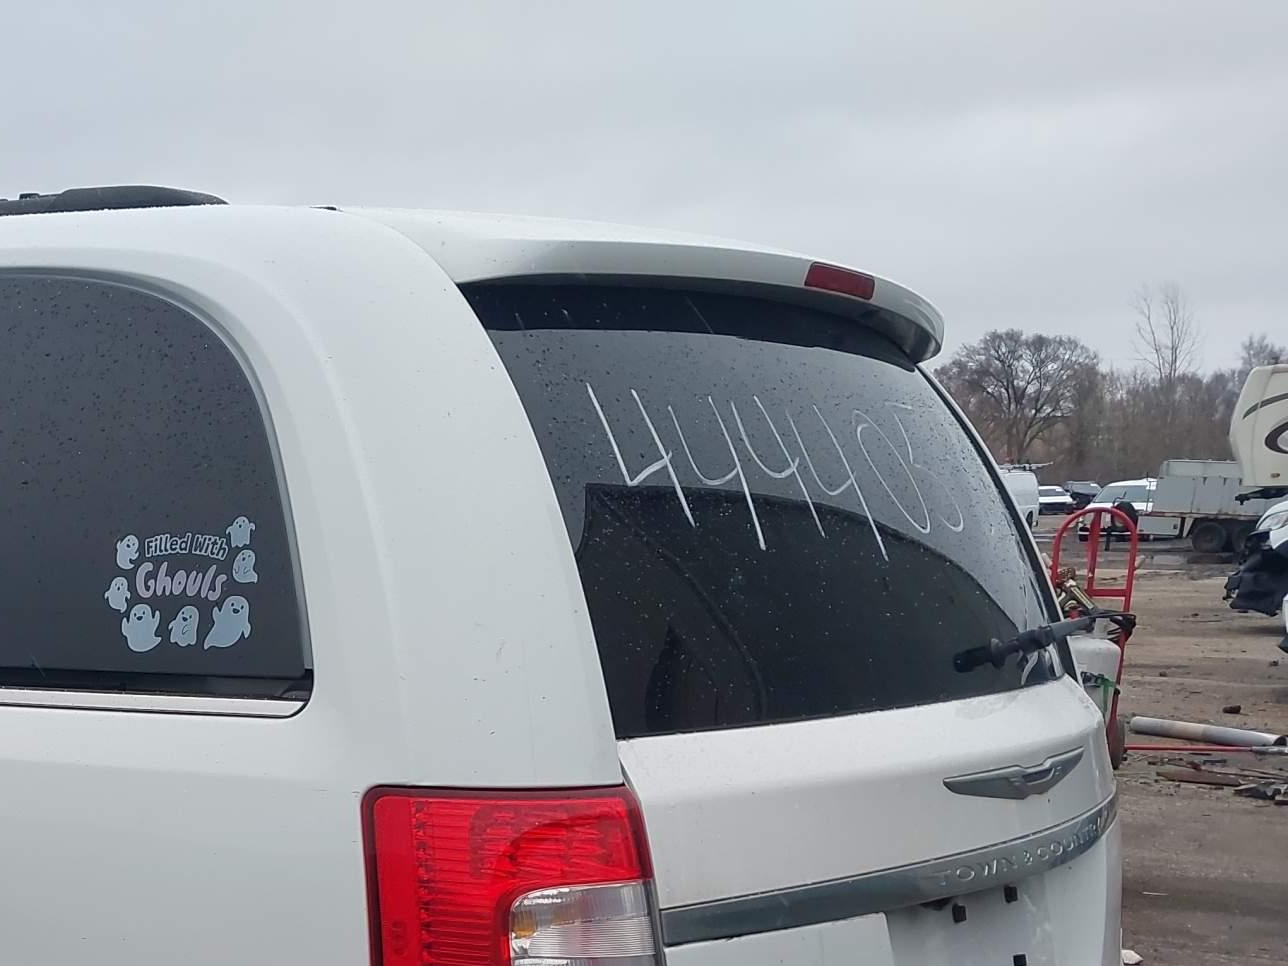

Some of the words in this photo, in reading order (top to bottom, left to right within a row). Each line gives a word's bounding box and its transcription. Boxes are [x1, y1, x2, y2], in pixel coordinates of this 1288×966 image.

[145, 533, 191, 557] Filled
[192, 534, 228, 560] With
[136, 561, 228, 601] Ghouls
